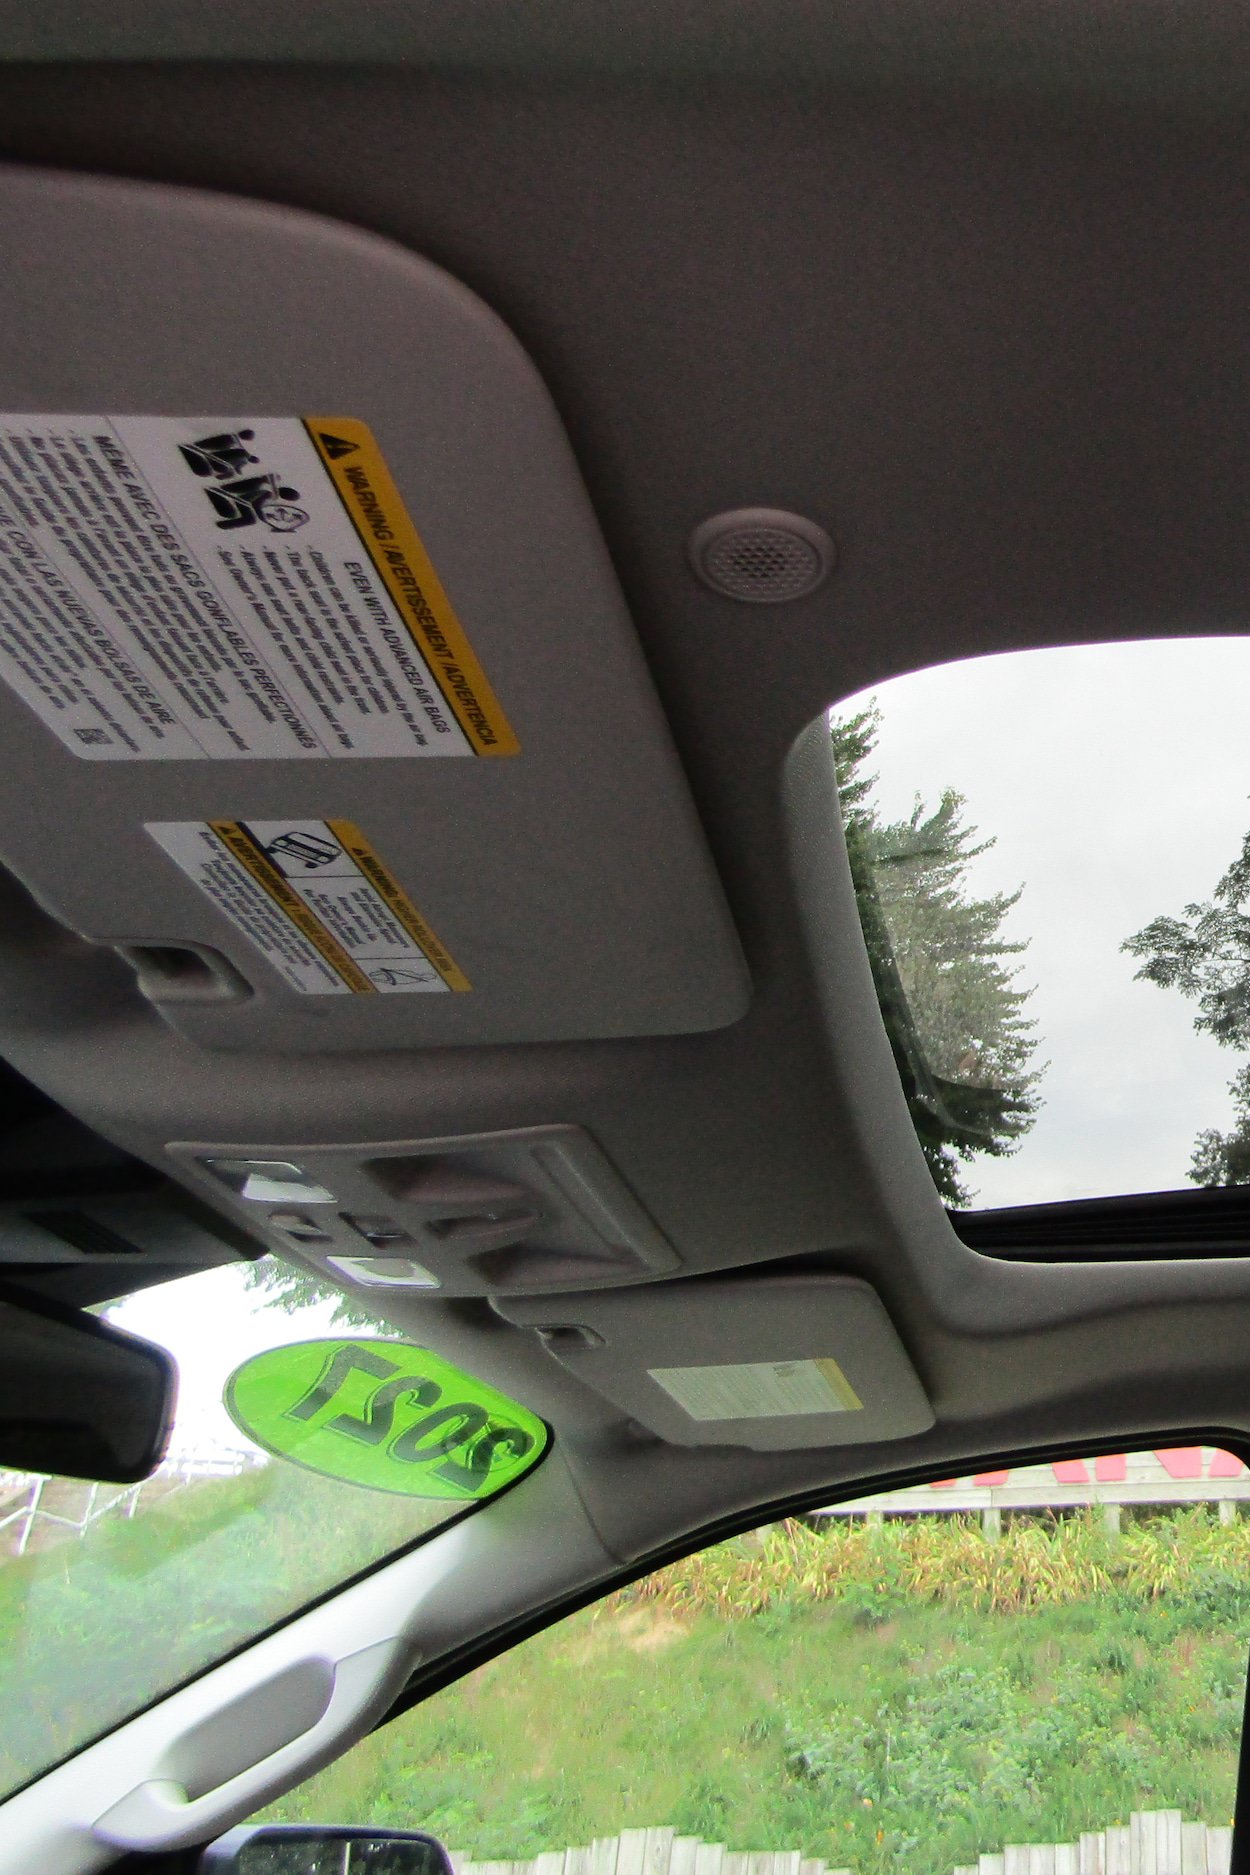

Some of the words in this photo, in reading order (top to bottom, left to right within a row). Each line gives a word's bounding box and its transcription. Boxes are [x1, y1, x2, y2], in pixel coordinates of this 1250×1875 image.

[339, 466, 398, 540] WARNING
[88, 435, 135, 479] MÊME
[121, 483, 163, 520] AVEC
[149, 523, 184, 551] DES
[170, 554, 209, 587] SACS
[195, 590, 262, 666] GONFLABLES
[248, 668, 319, 749] PERFECTIONNÉS
[342, 561, 376, 593] EVEN
[4, 530, 42, 558] CON
[30, 562, 65, 586] LAS
[53, 590, 105, 636] NUEVAS
[93, 639, 144, 683] BOLSAS
[131, 685, 157, 699] DE
[144, 701, 178, 724] AIRE
[361, 596, 394, 625] WITH
[378, 628, 426, 685] ADVANCED
[411, 687, 436, 704] AIR
[422, 706, 451, 733] BAGS
